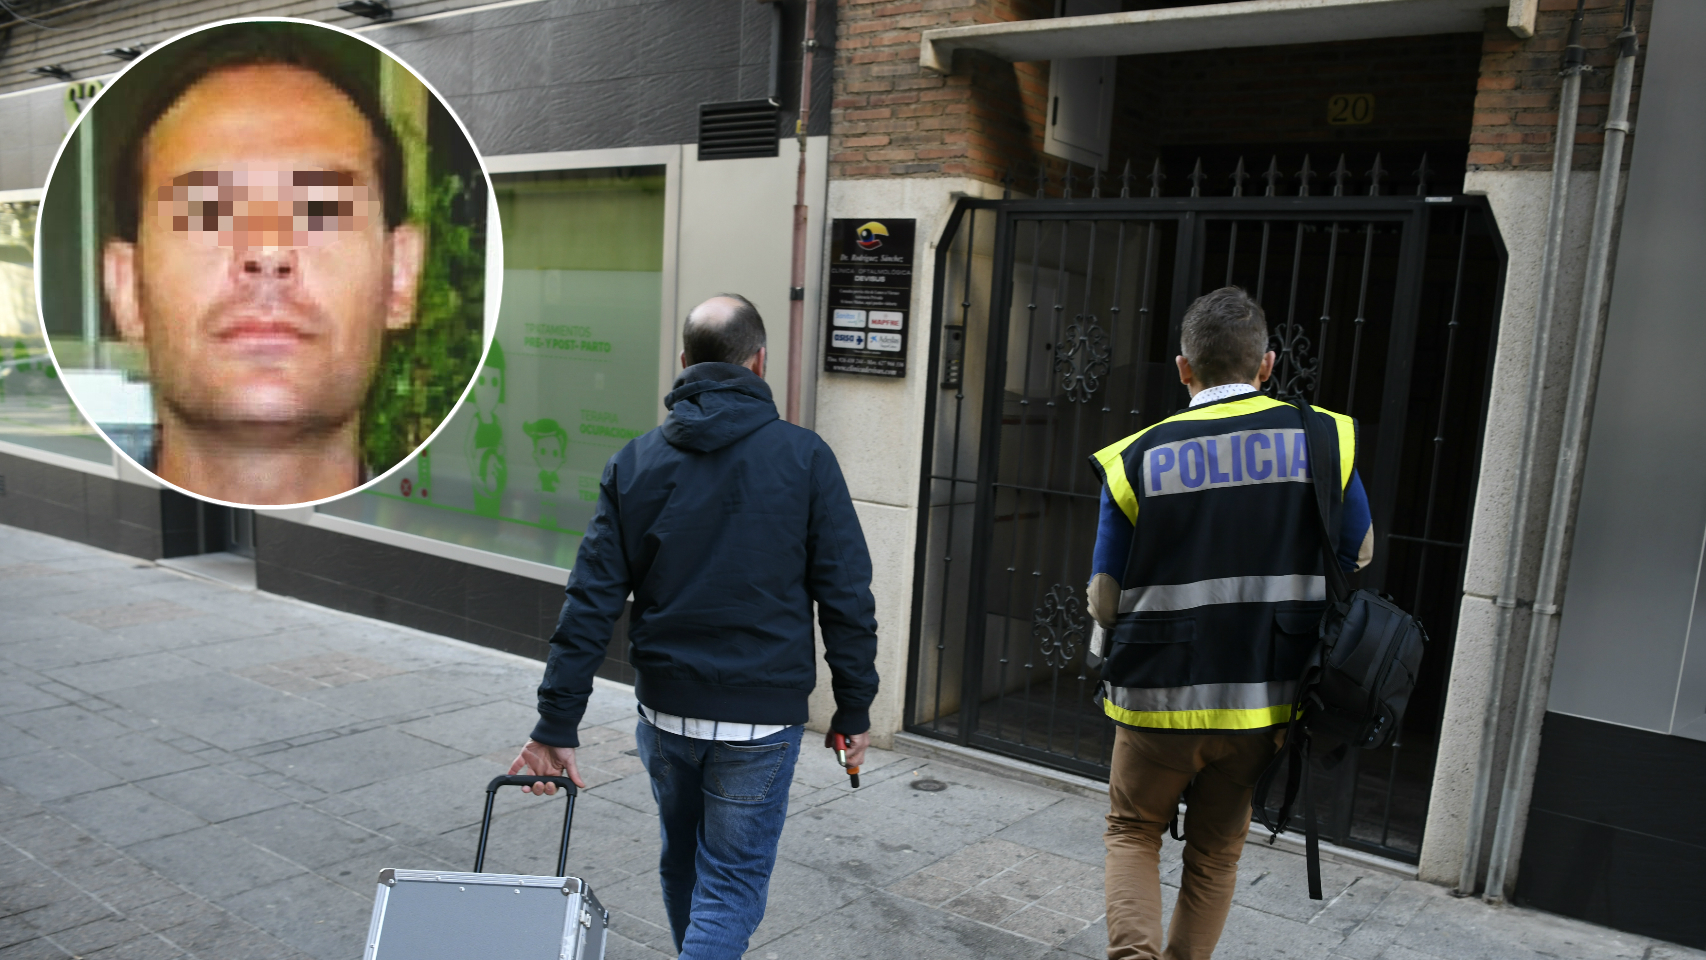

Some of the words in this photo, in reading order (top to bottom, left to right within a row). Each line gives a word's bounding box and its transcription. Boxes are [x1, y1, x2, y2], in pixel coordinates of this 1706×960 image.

[1332, 96, 1369, 122] 20
[525, 323, 592, 338] TRATAMIENTOS
[580, 340, 612, 353] PARTO
[581, 409, 619, 423] TERAPIA
[1150, 432, 1312, 492] POLICIA
